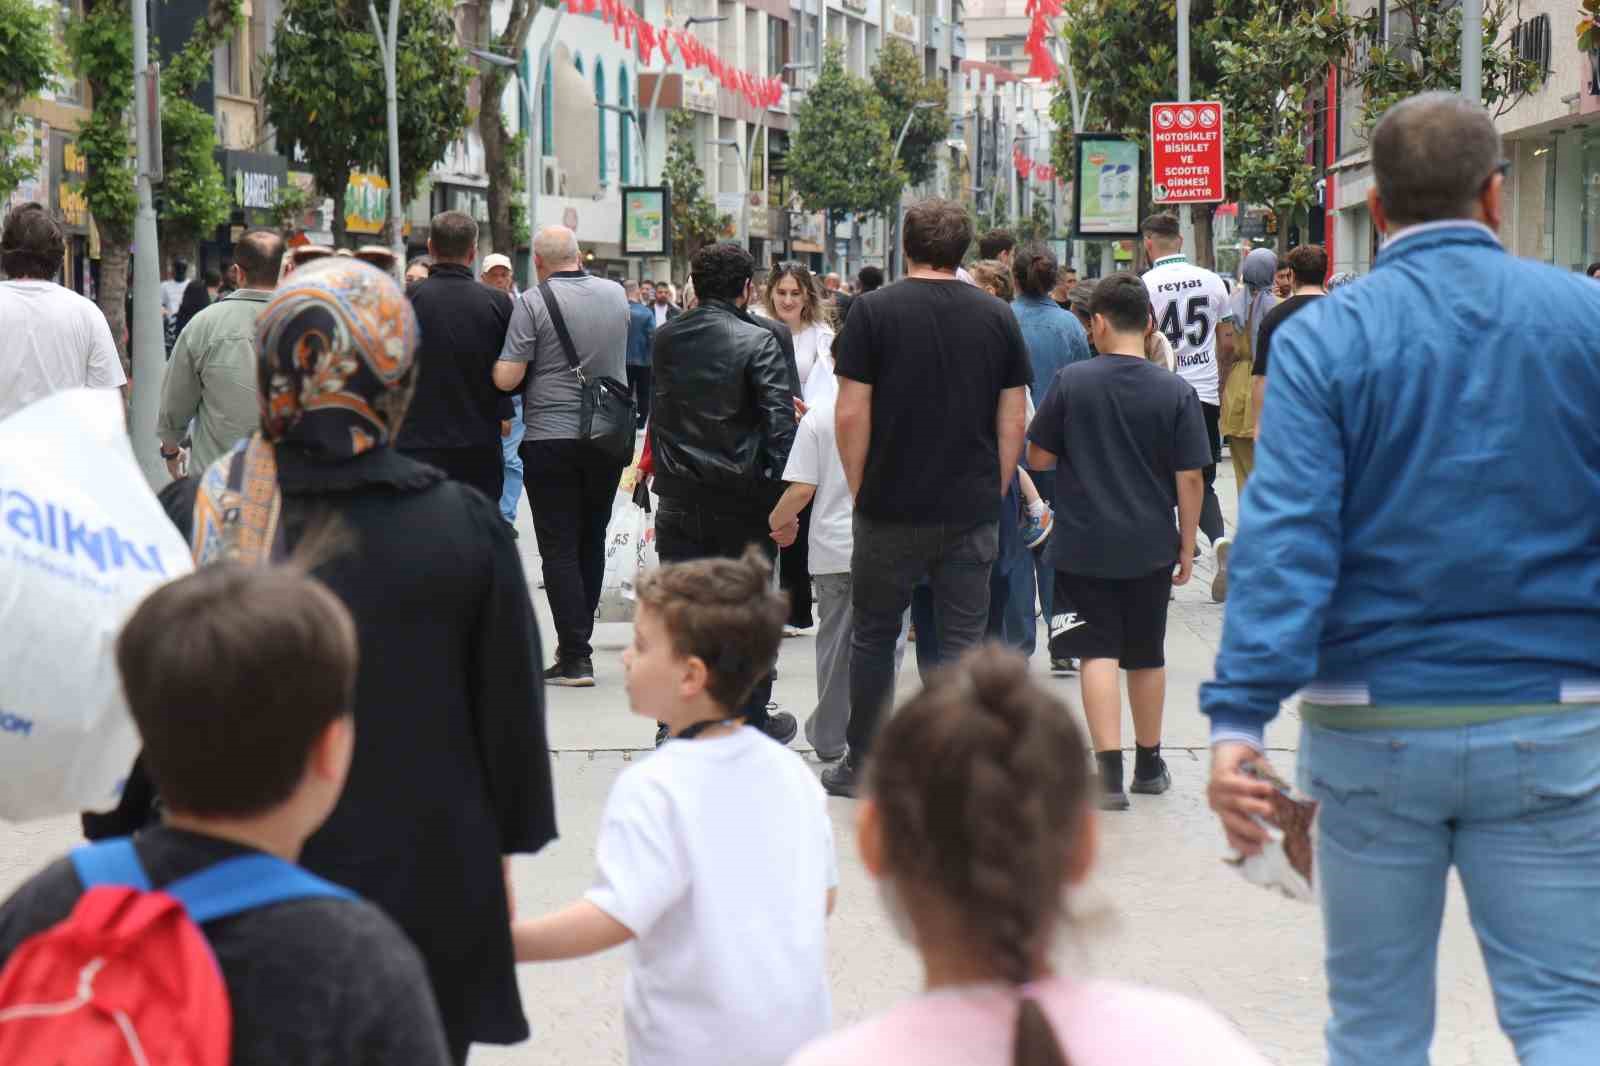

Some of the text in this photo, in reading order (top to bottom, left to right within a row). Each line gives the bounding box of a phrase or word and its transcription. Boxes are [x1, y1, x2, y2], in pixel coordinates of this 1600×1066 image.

[1156, 131, 1217, 141] MOTOSİKLET
[1165, 143, 1209, 153] BİSİKLET
[1180, 155, 1194, 164] VE
[1165, 166, 1210, 176] SCOOTER
[1167, 176, 1208, 187] GİRMESİ
[1158, 295, 1210, 350] 45
